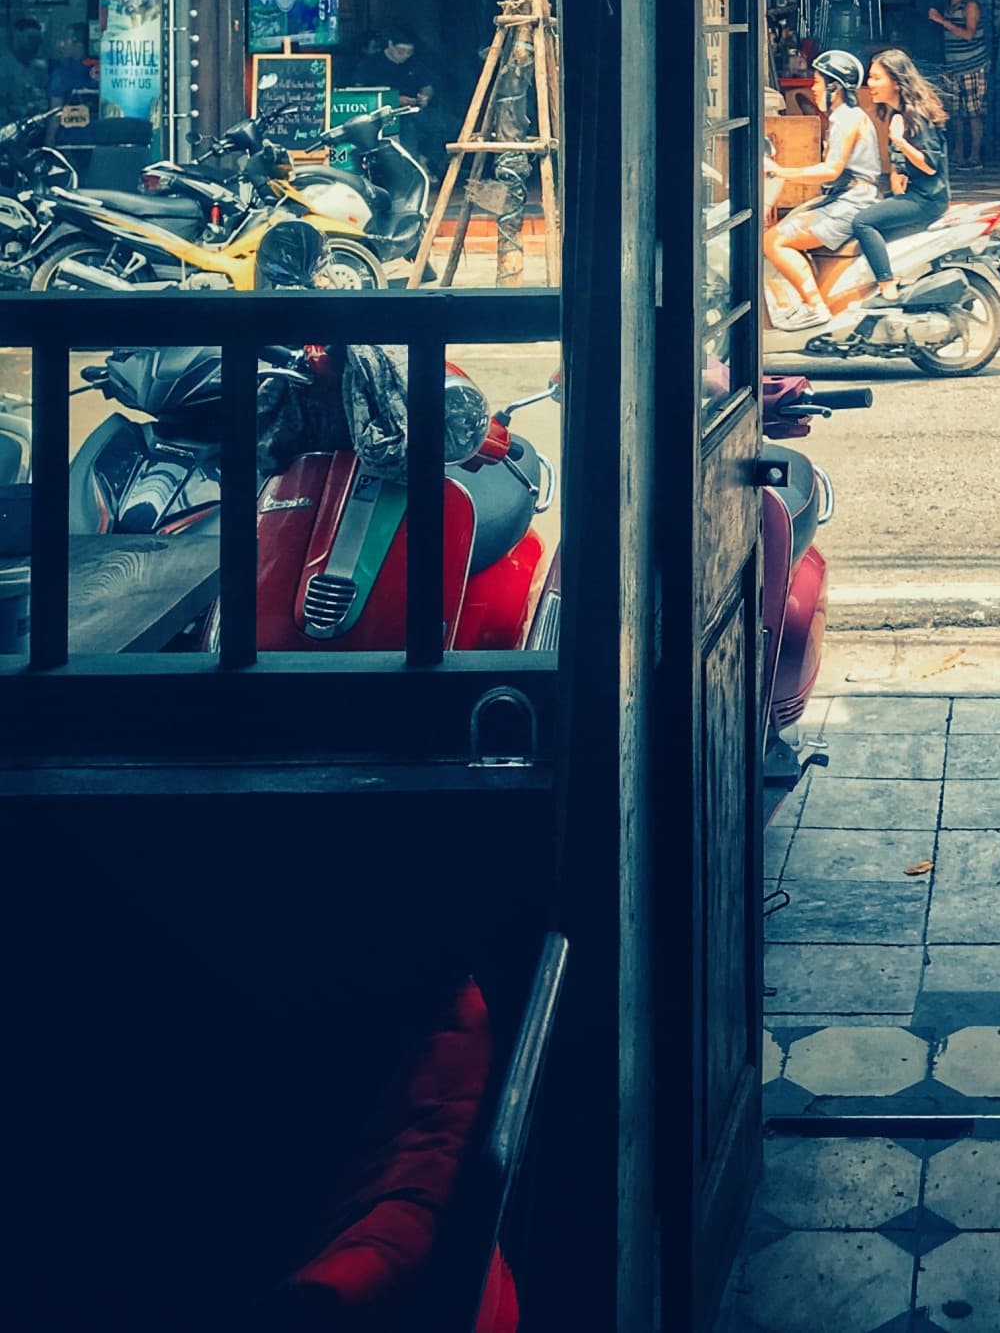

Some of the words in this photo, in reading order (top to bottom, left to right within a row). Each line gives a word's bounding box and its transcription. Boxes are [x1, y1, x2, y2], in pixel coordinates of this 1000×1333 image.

[109, 39, 158, 67] TRAVEL
[111, 78, 136, 89] WITH
[138, 77, 152, 89] US
